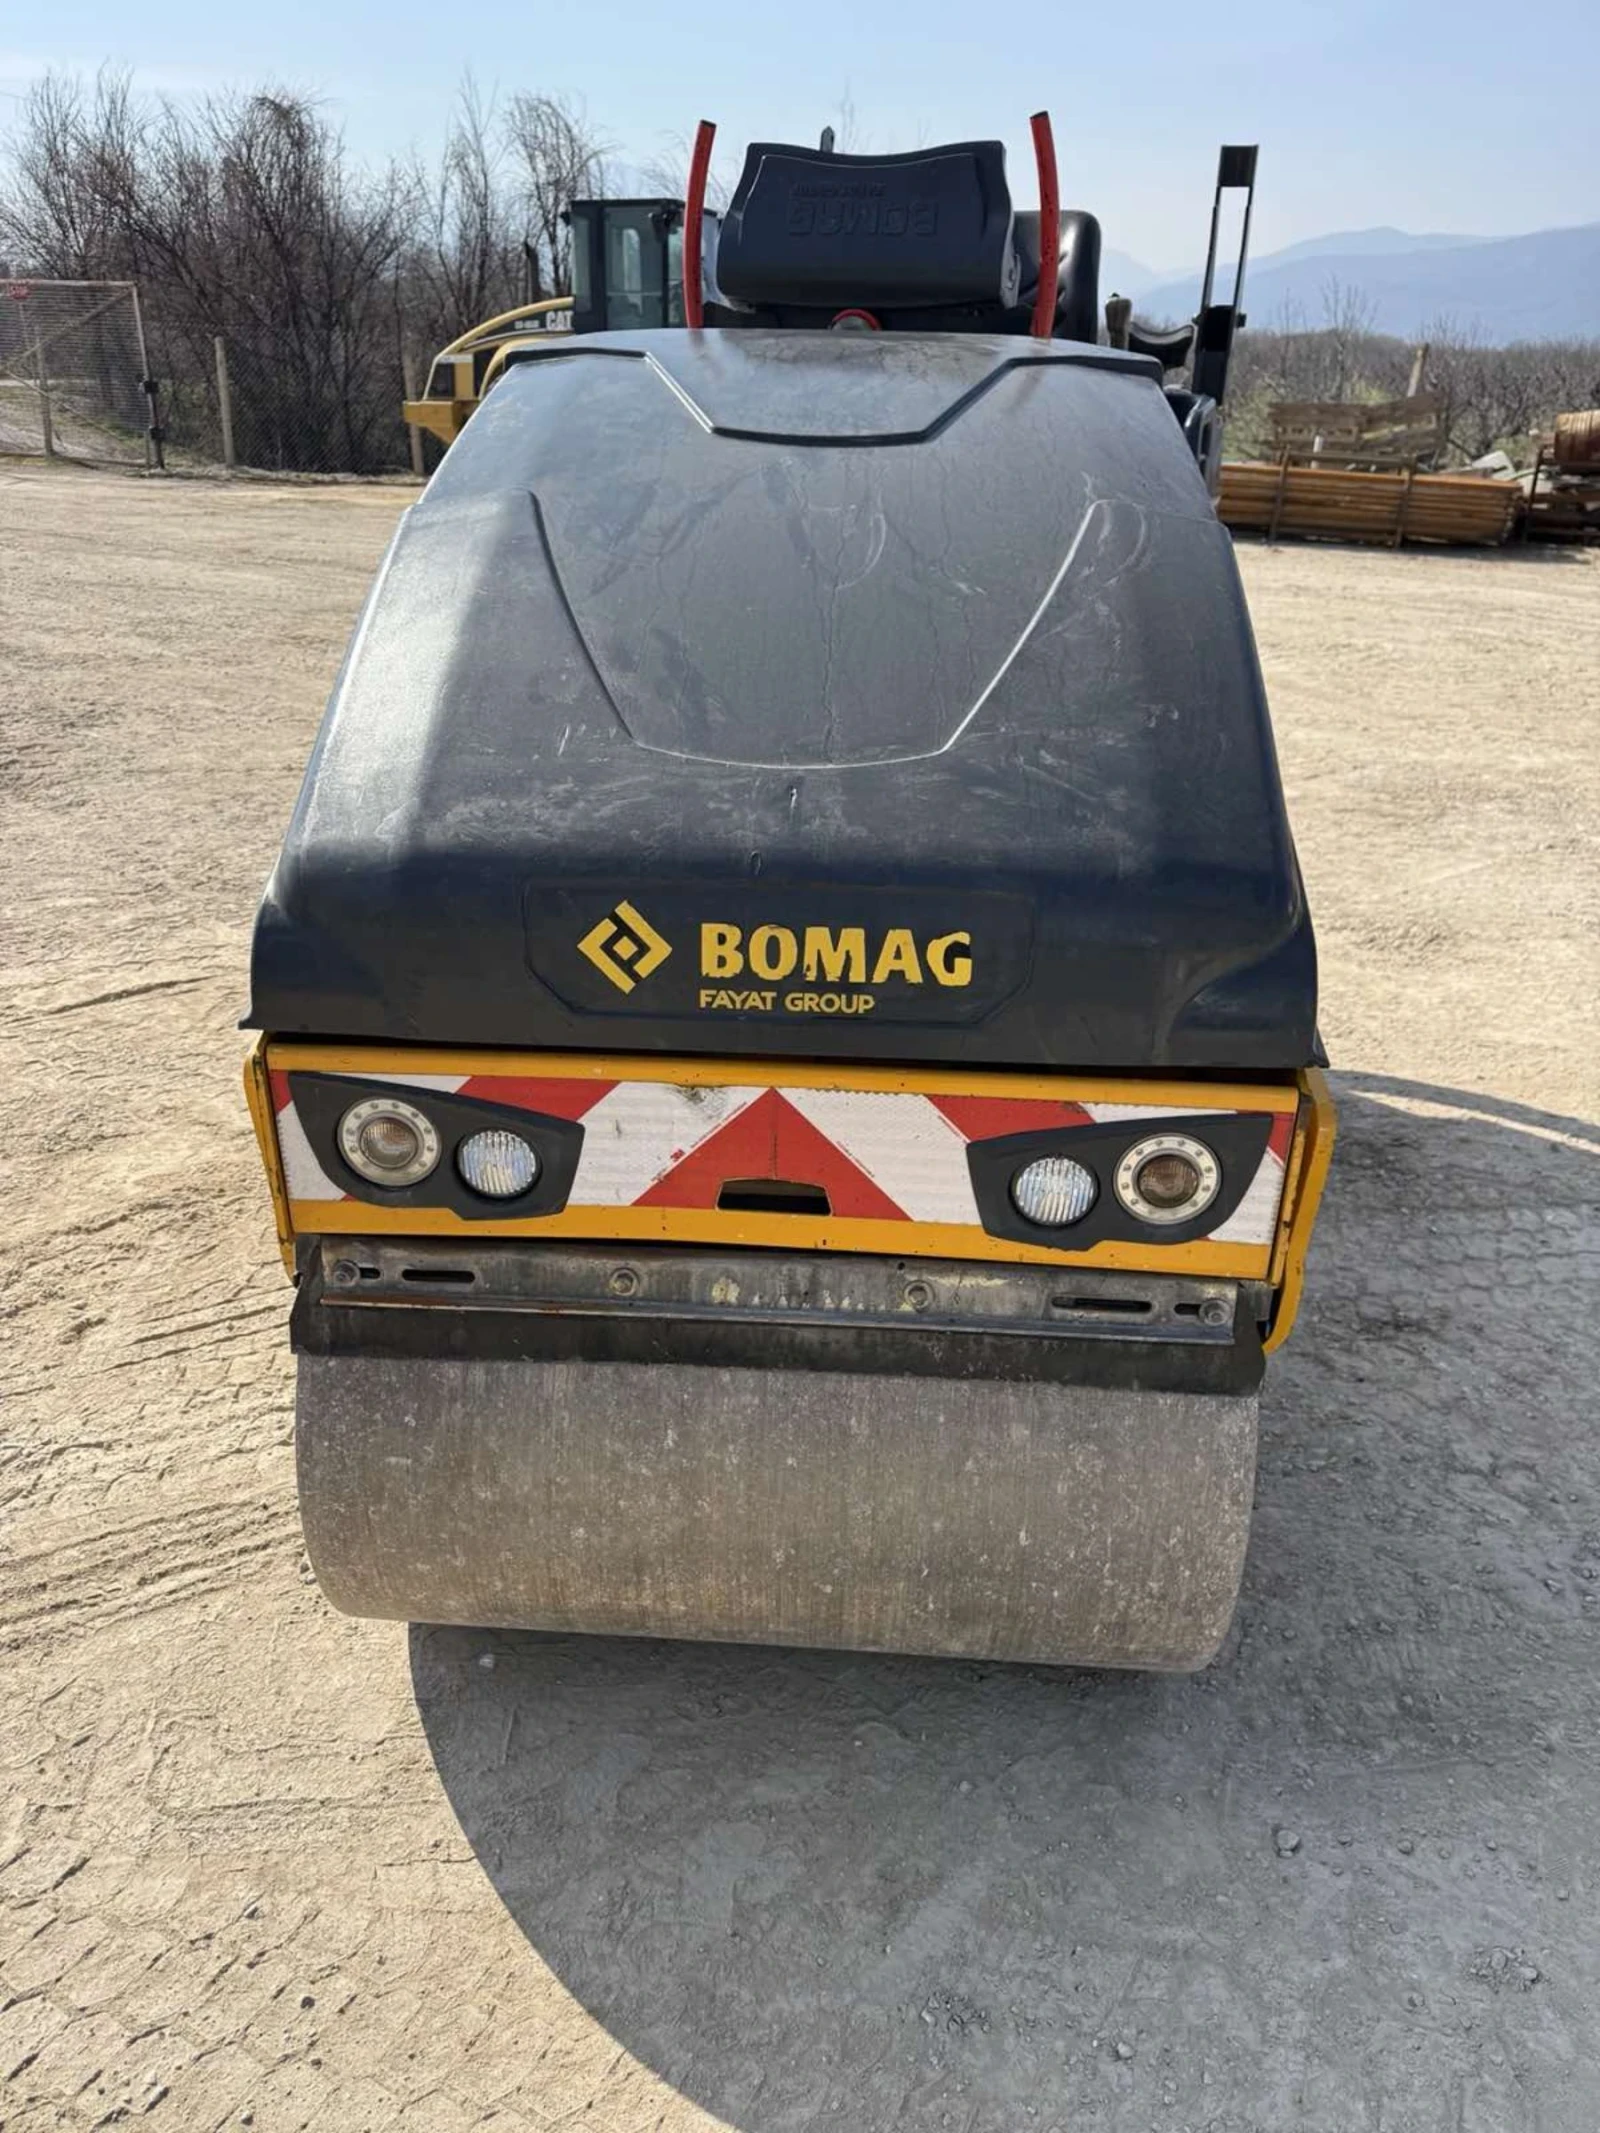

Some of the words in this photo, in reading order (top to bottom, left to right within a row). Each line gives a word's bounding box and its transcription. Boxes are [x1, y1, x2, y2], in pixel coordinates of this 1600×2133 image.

[545, 310, 574, 331] CAT
[701, 922, 972, 987] BOMAG
[699, 990, 776, 1010] FAYAT
[784, 993, 875, 1014] GROUP
